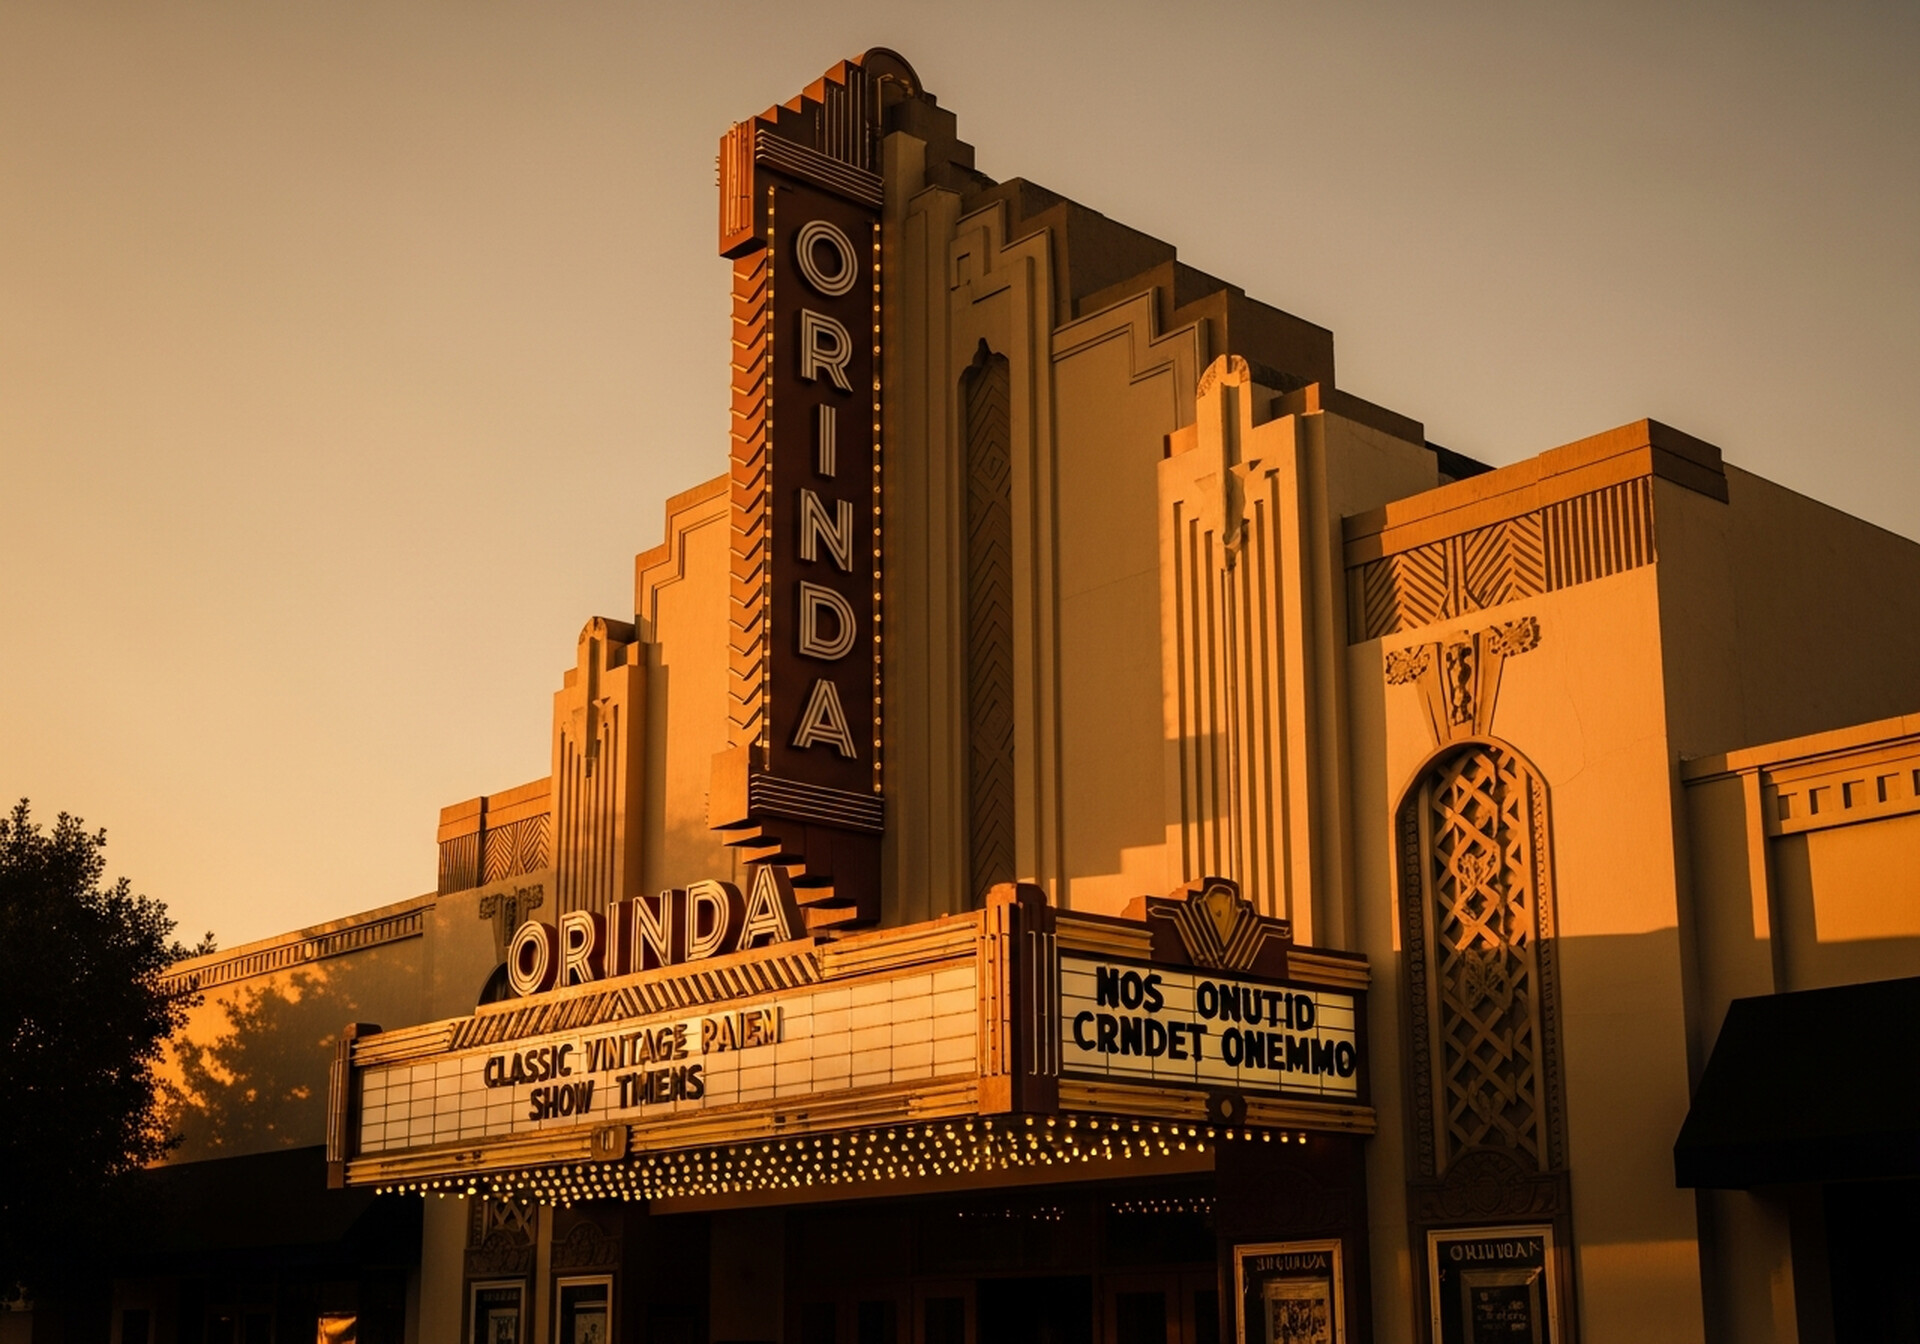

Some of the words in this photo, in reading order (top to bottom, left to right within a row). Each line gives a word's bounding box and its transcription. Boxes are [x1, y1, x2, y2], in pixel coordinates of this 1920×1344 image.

[794, 219, 859, 760] ORINDA
[507, 864, 796, 996] ORINDA
[1096, 966, 1164, 1013] NOS
[1196, 980, 1315, 1031] ONUTID
[484, 1043, 574, 1089] CLASSIC
[584, 1023, 689, 1073] VINTAGE
[1073, 1011, 1208, 1062] CRNDET
[1221, 1026, 1356, 1078] ONEMMO
[529, 1079, 595, 1121] SHOW
